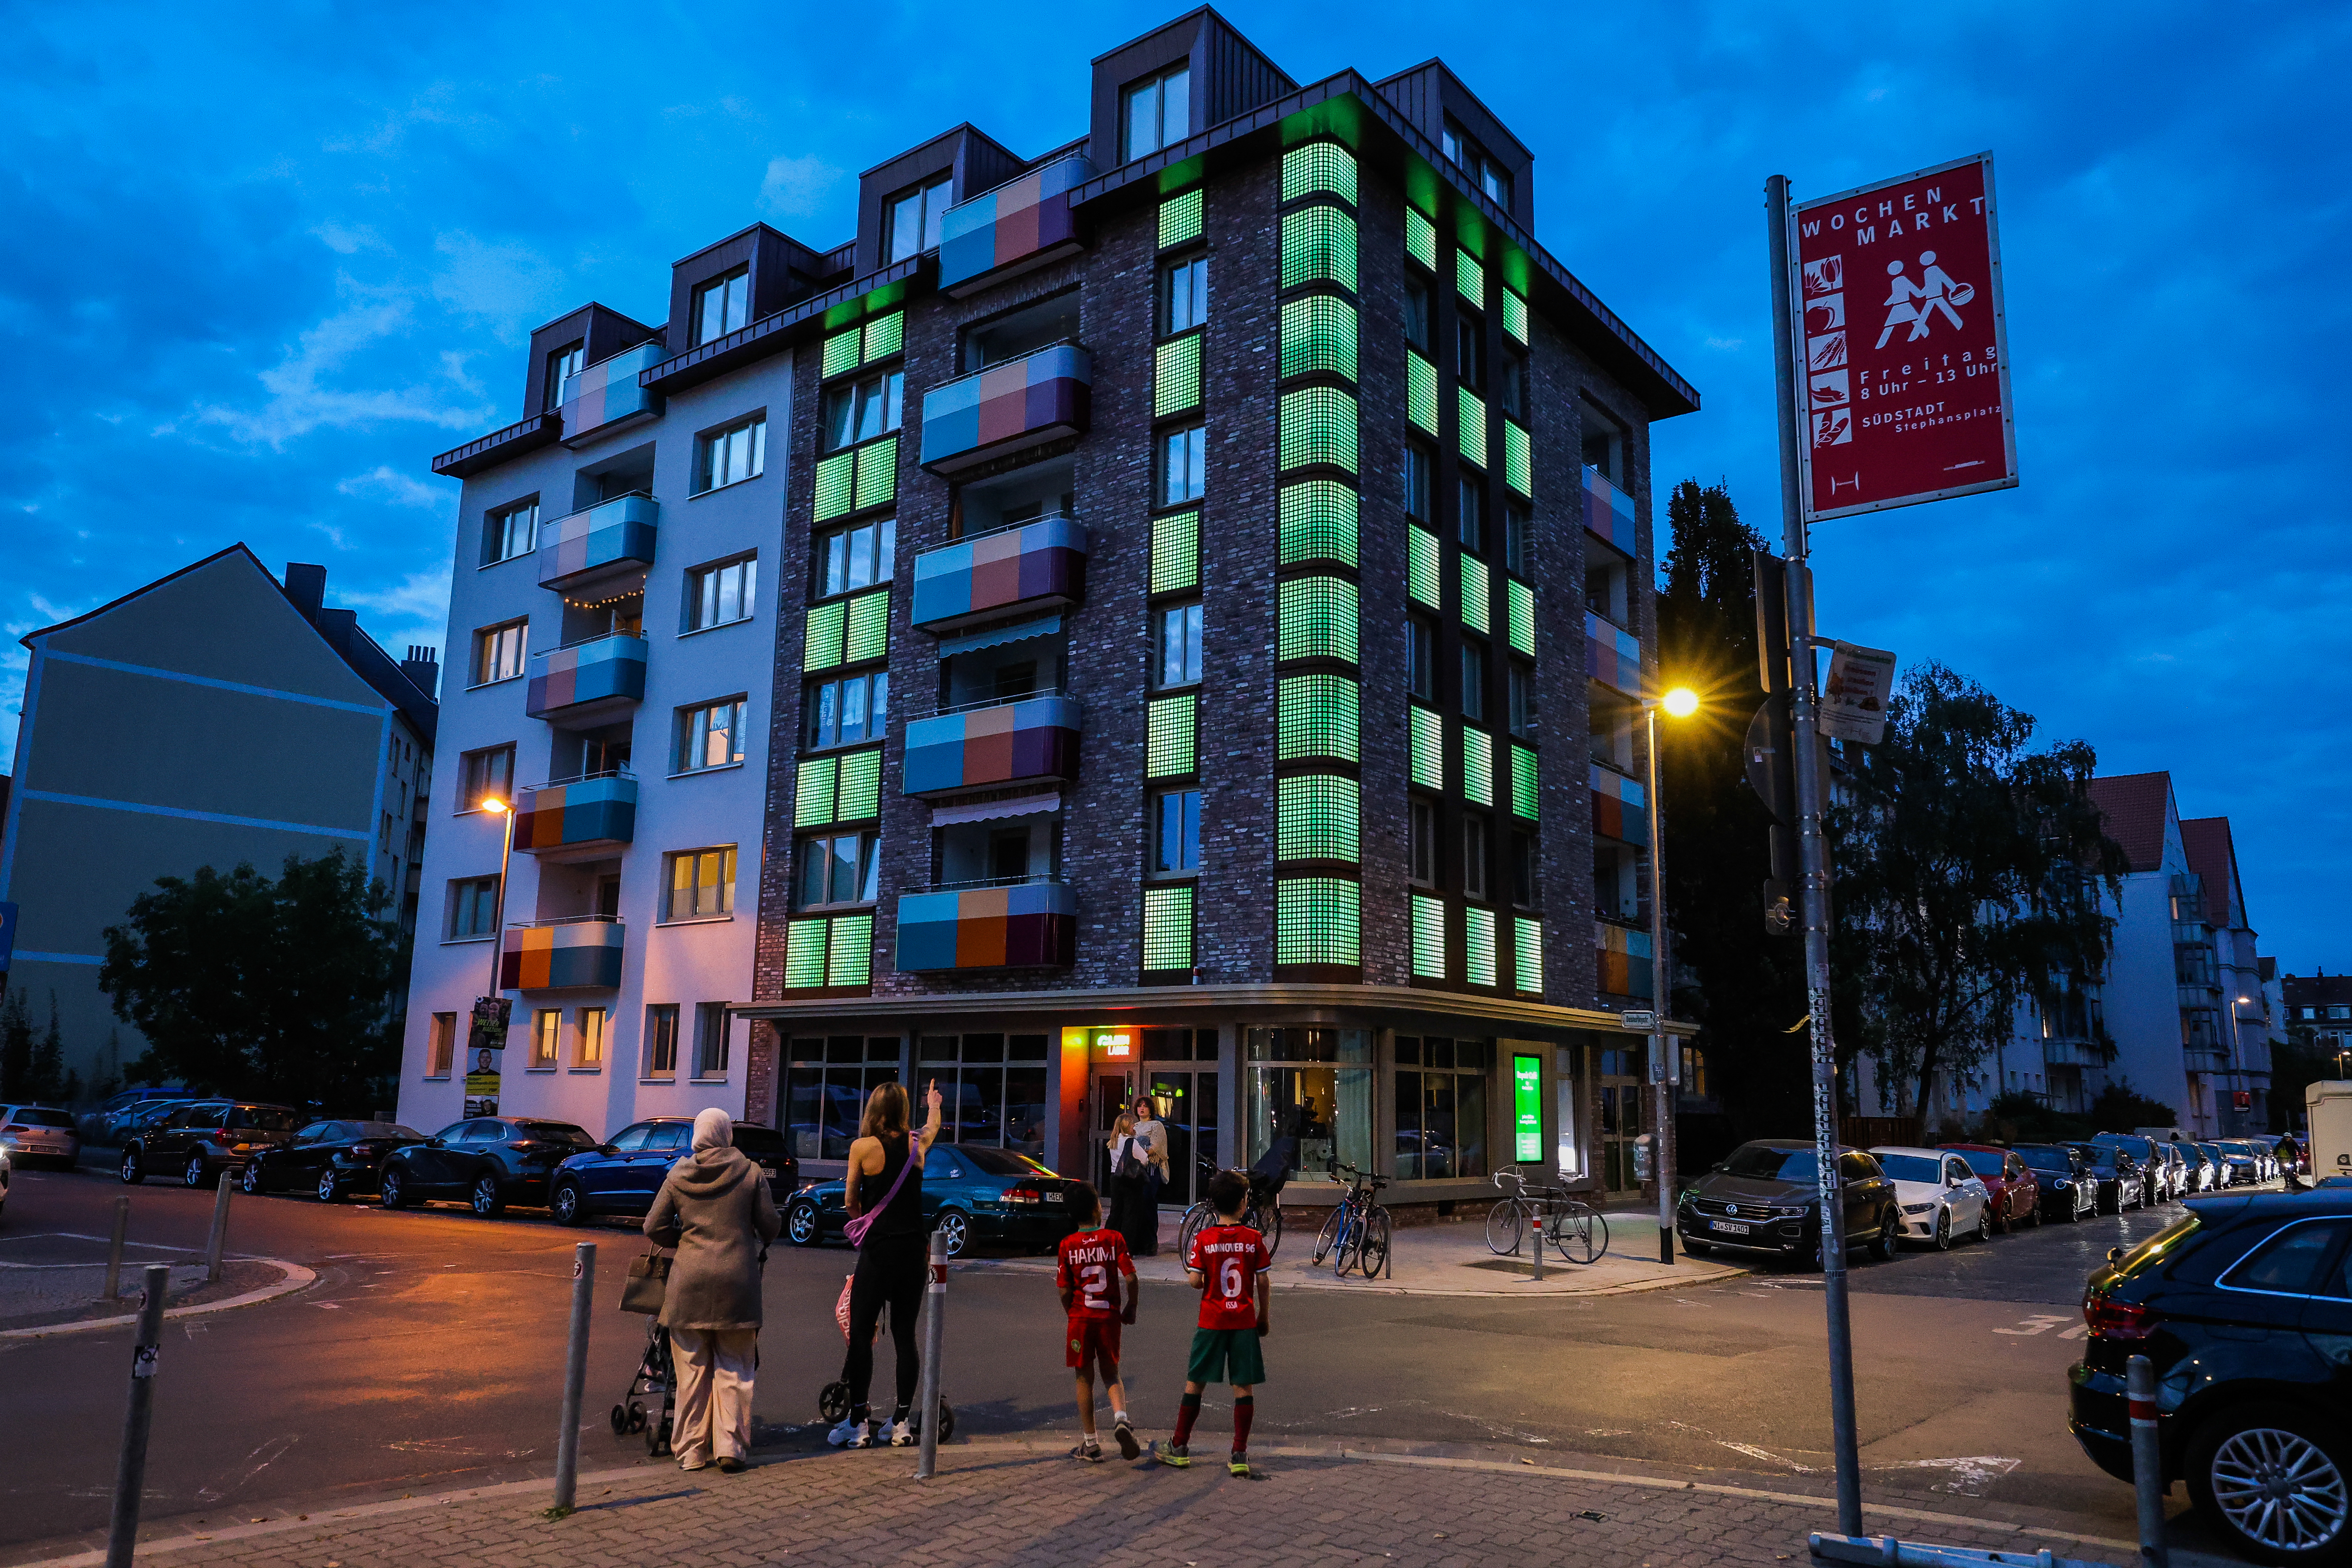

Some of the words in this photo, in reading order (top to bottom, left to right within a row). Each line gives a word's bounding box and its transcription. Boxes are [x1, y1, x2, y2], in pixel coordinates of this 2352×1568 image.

[1802, 187, 1940, 238] WOCHEN
[1857, 196, 1984, 246] MARKT
[1860, 346, 1996, 384] Freitag
[1860, 388, 1870, 399] 8
[1879, 382, 1908, 396] Uhr
[1936, 369, 1956, 384] 13
[1966, 362, 1998, 377] Uhr
[1862, 401, 1945, 427] SÜDSTADT
[1895, 406, 2002, 433] Stephansplatz
[1733, 1225, 1748, 1234] 1401
[1068, 1246, 1115, 1265] HAKIMI
[1204, 1242, 1244, 1255] HANNOVER
[1245, 1243, 1255, 1253] 96
[1081, 1265, 1110, 1309] 2
[1220, 1257, 1242, 1298] 6
[1225, 1301, 1238, 1309] ISSA
